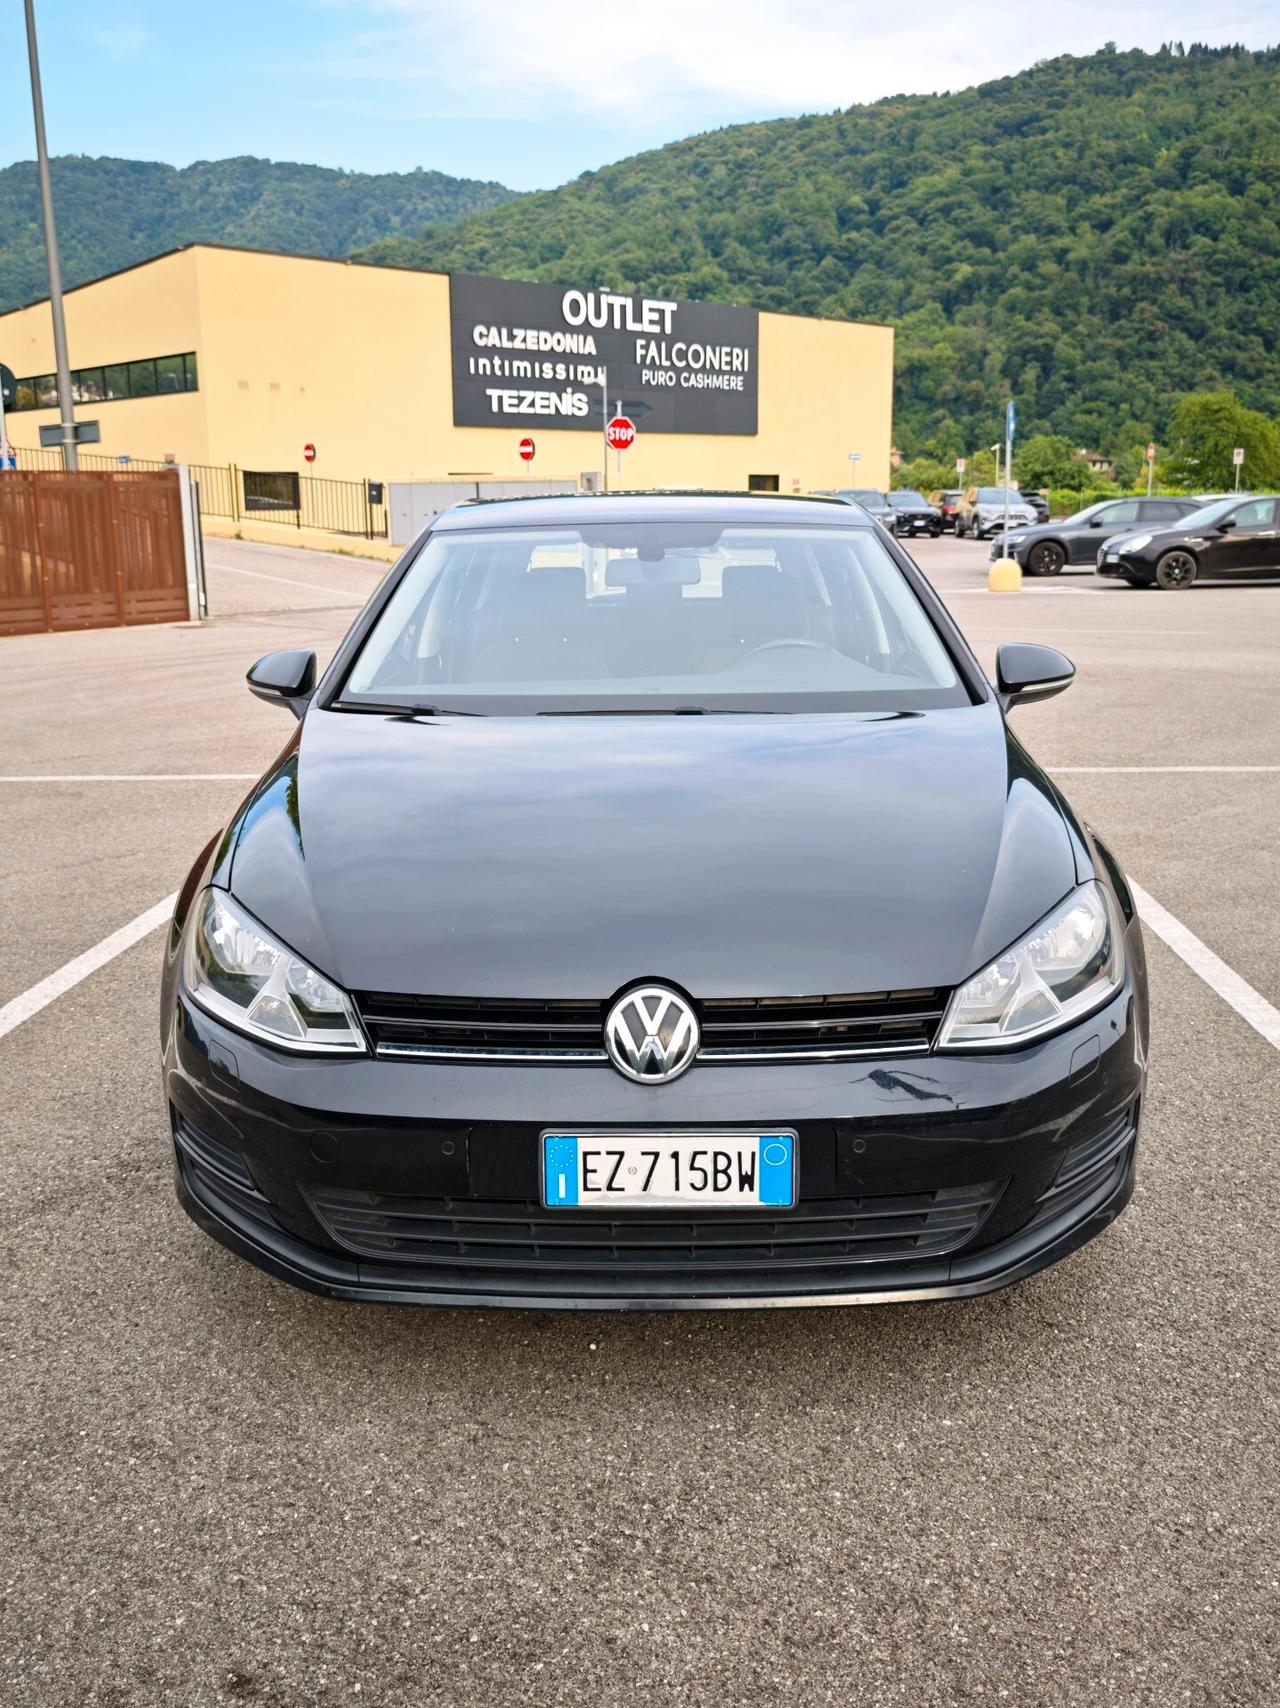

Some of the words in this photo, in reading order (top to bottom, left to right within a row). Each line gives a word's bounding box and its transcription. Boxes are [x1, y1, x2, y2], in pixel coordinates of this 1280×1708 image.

[562, 290, 678, 335] OUTLET
[472, 324, 598, 356] CALZEDONIA
[635, 338, 749, 373] FALCONERI
[641, 369, 676, 387] PURO
[680, 371, 744, 391] CASHMERE
[608, 426, 634, 441] STOP
